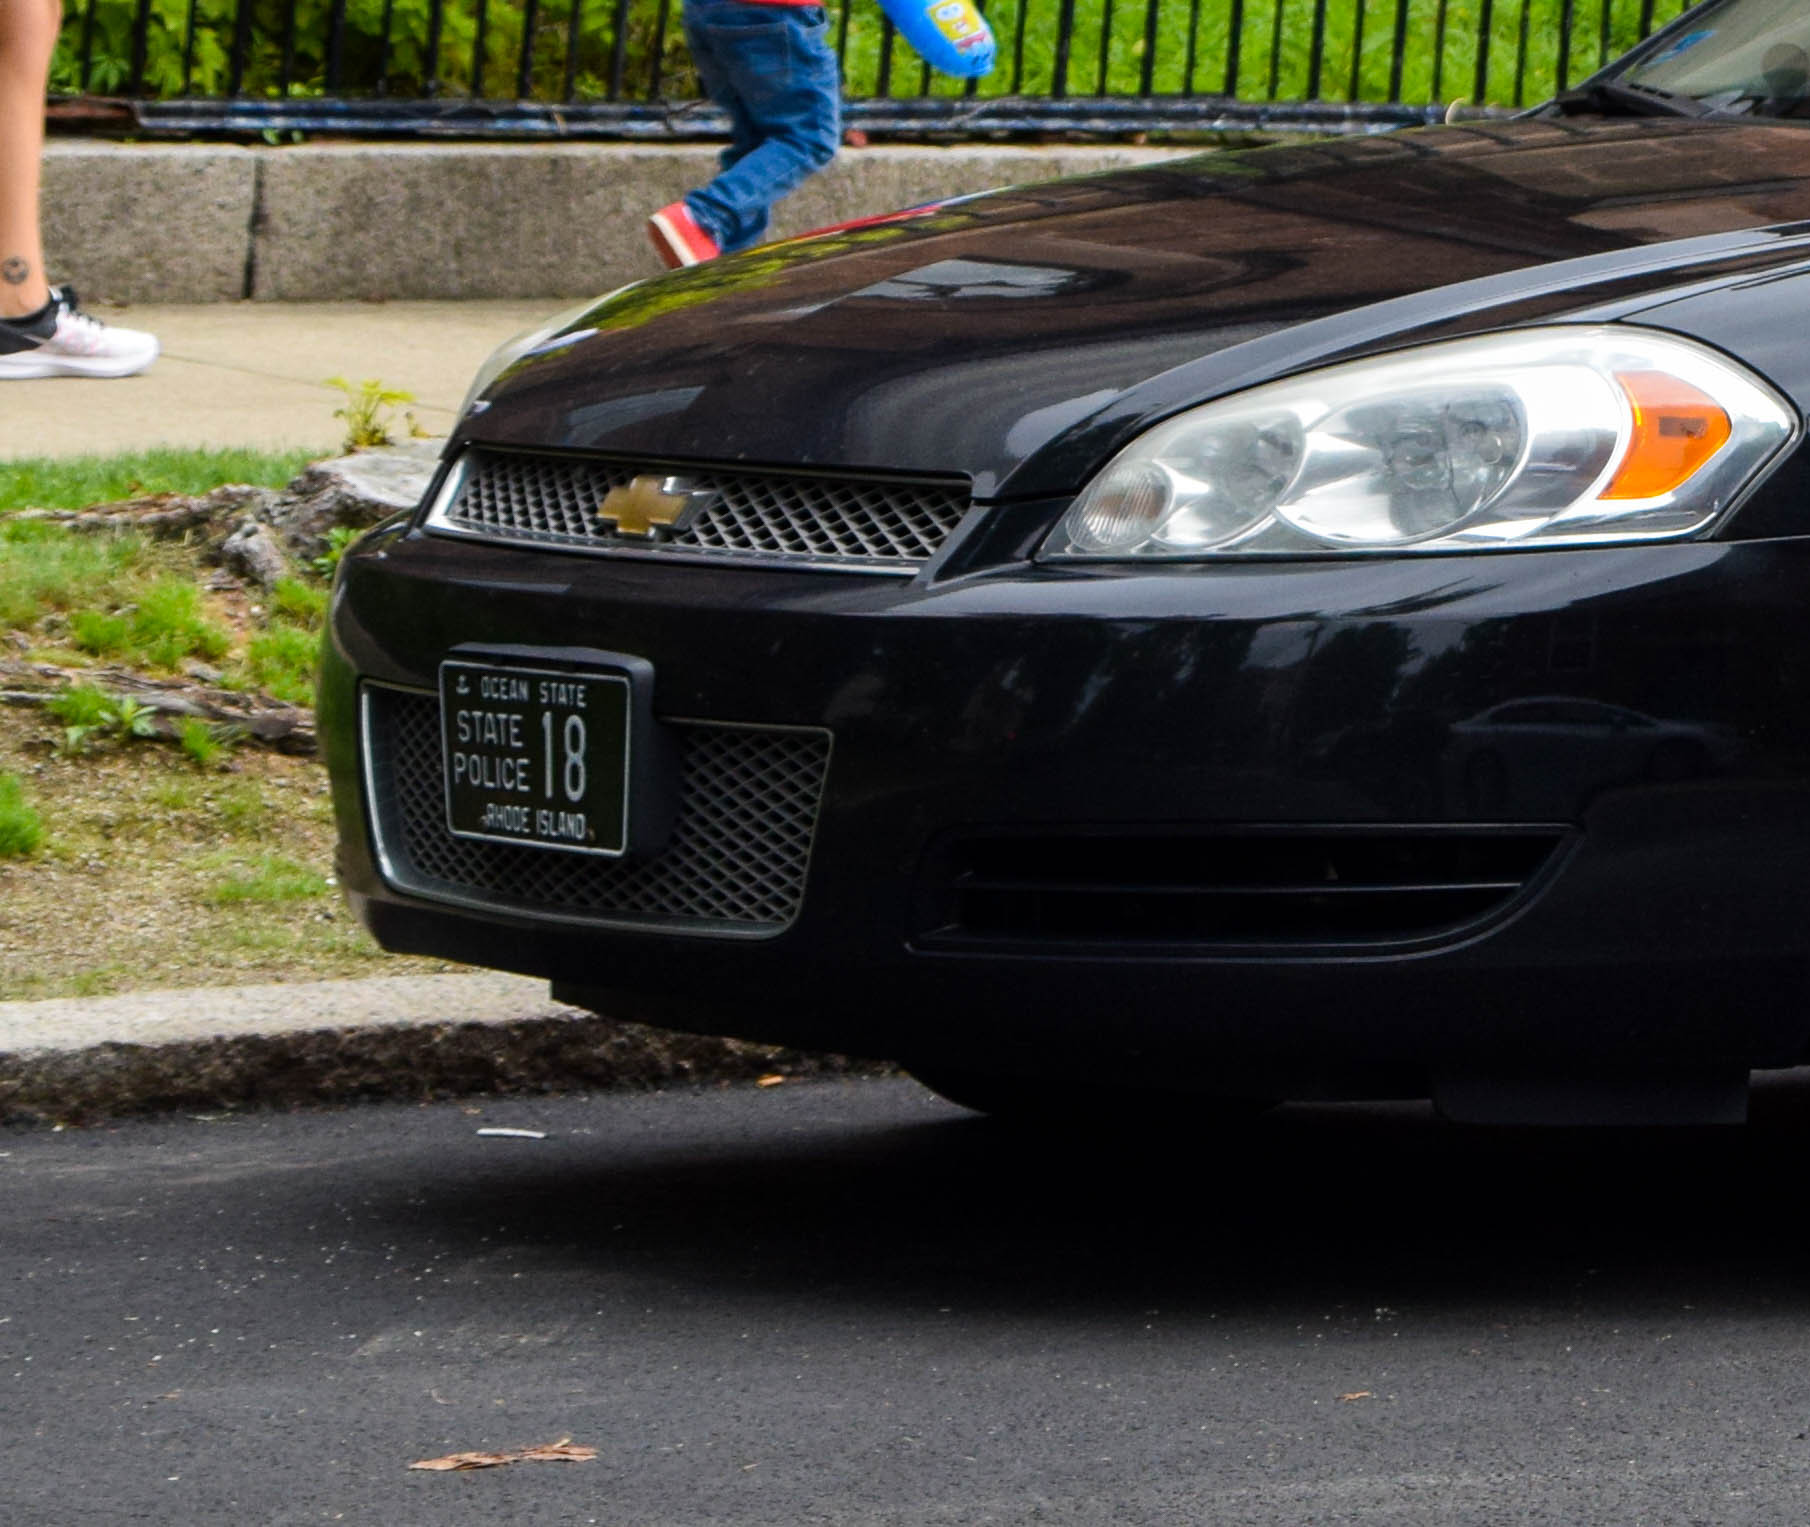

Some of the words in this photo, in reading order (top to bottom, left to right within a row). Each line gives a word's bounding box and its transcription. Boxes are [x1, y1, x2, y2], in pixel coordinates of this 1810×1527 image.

[480, 675, 530, 703] OCEAN
[538, 681, 587, 708] STATE
[456, 709, 524, 748] STATE
[453, 751, 531, 792] POLICE
[541, 710, 586, 803] 18
[486, 802, 531, 833] RHODE
[535, 808, 586, 840] ISLAND
